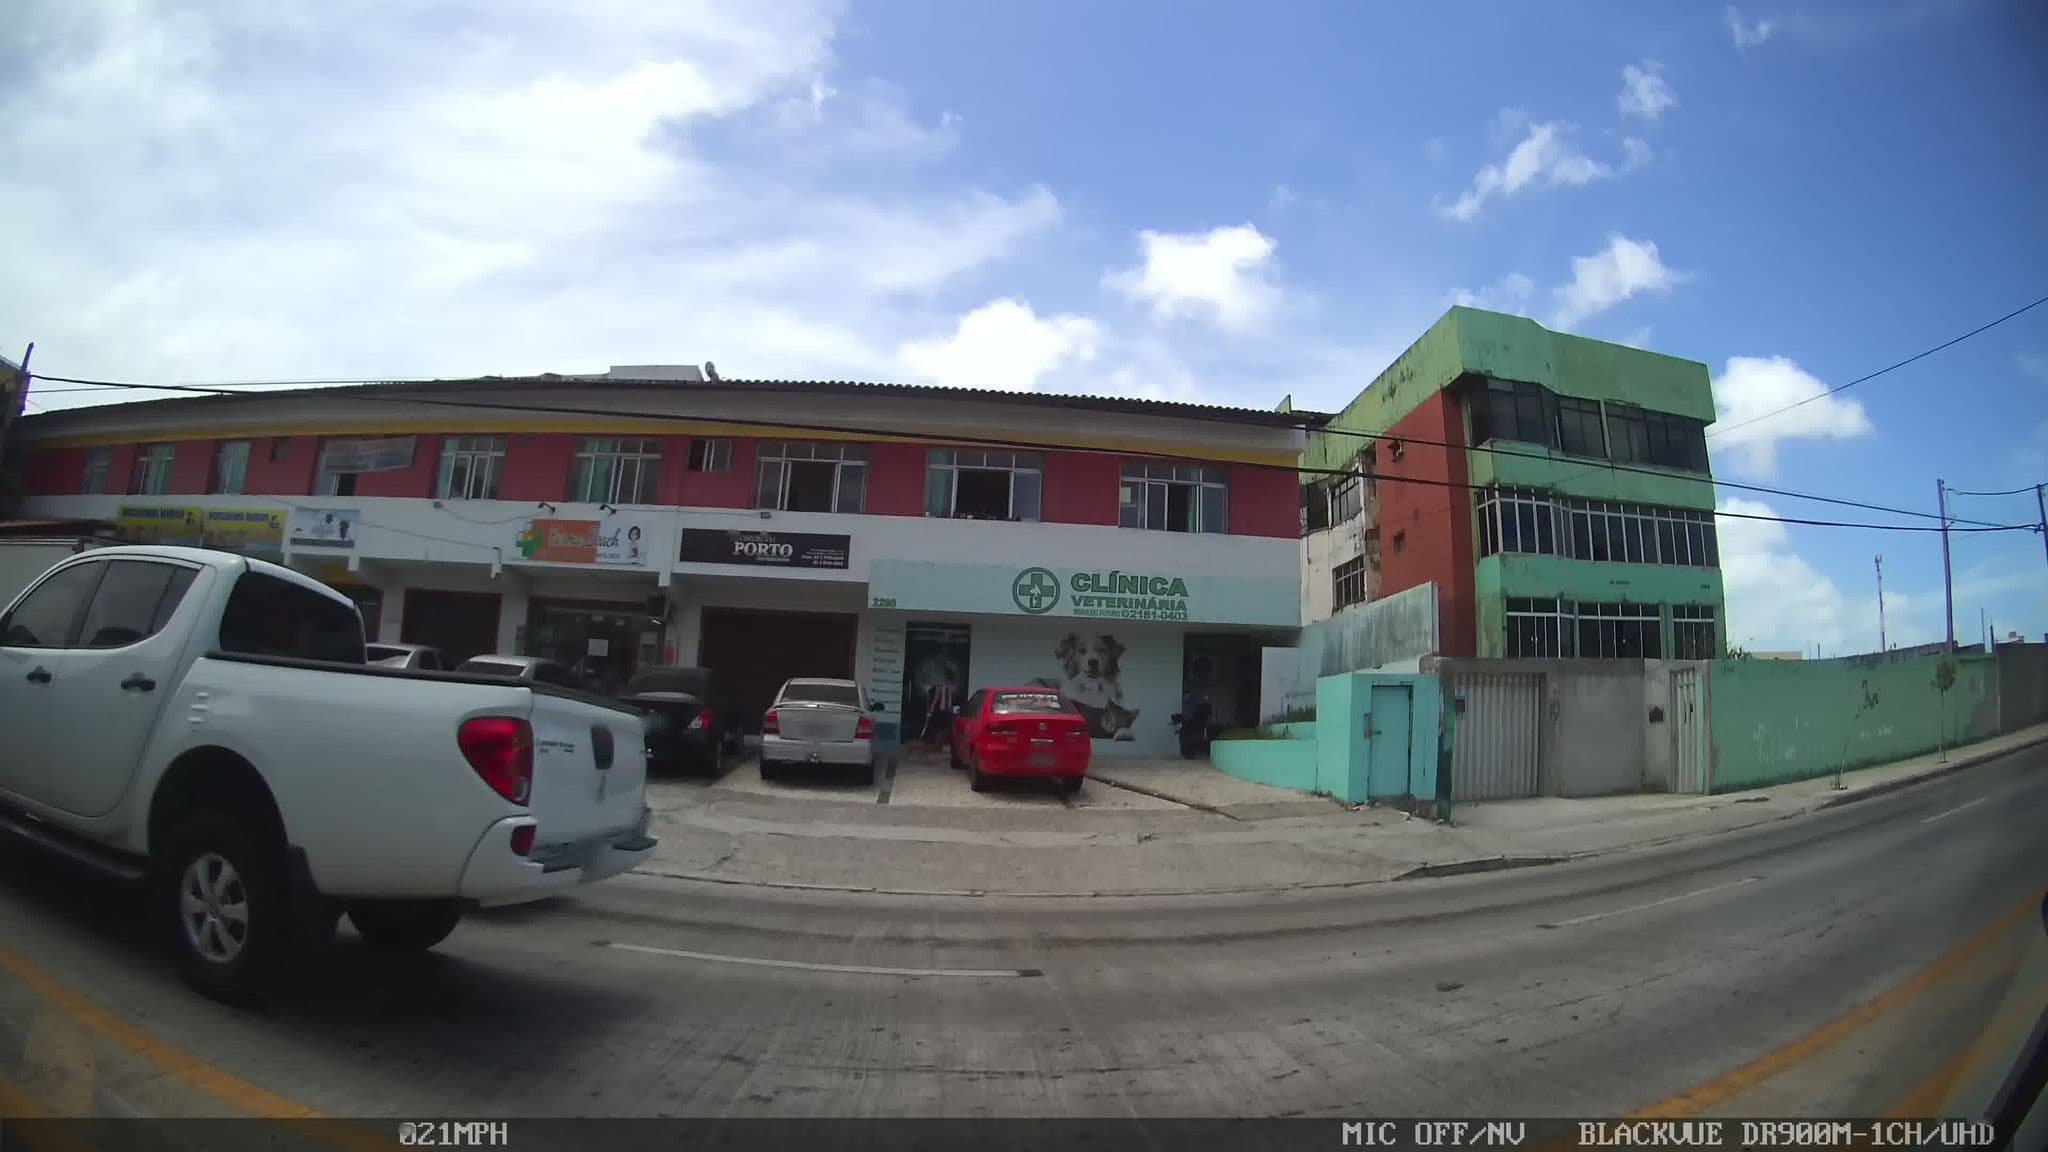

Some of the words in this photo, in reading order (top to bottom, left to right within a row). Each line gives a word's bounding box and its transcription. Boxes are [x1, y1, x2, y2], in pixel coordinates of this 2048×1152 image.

[733, 542, 793, 557] PORTO
[1071, 570, 1188, 597] CLÍNICA
[1073, 595, 1188, 611] VETERINÁRIA
